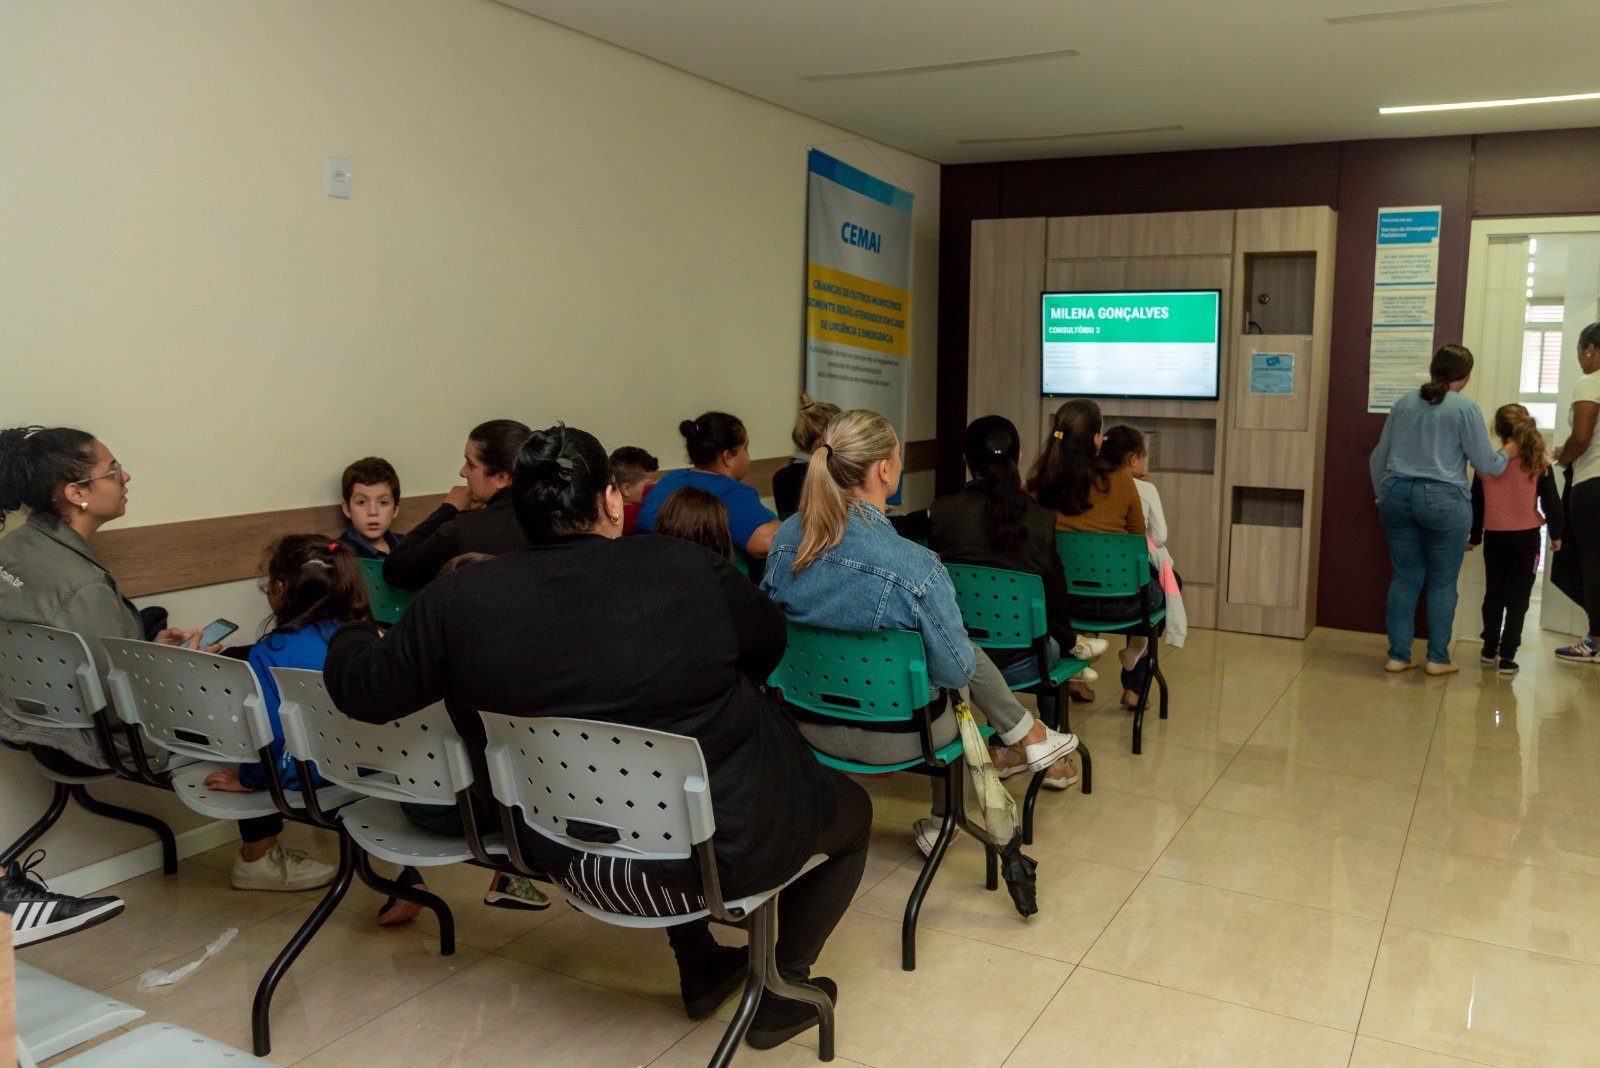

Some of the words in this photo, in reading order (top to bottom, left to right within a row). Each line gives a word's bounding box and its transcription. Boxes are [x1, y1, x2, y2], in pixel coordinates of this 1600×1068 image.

[841, 221, 880, 253] CEMAI
[812, 280, 841, 295] CRIANÇAS
[842, 286, 850, 297] DE
[850, 288, 871, 302] OUTROS
[1050, 307, 1095, 320] MILENA
[1098, 306, 1169, 321] GONÇALVES
[820, 319, 828, 330] DE
[829, 321, 857, 335] URGÊNCIA
[861, 327, 893, 343] EMERGÊNCIA
[1048, 325, 1095, 334] CONSULTÓRIO
[1096, 326, 1101, 334] 3
